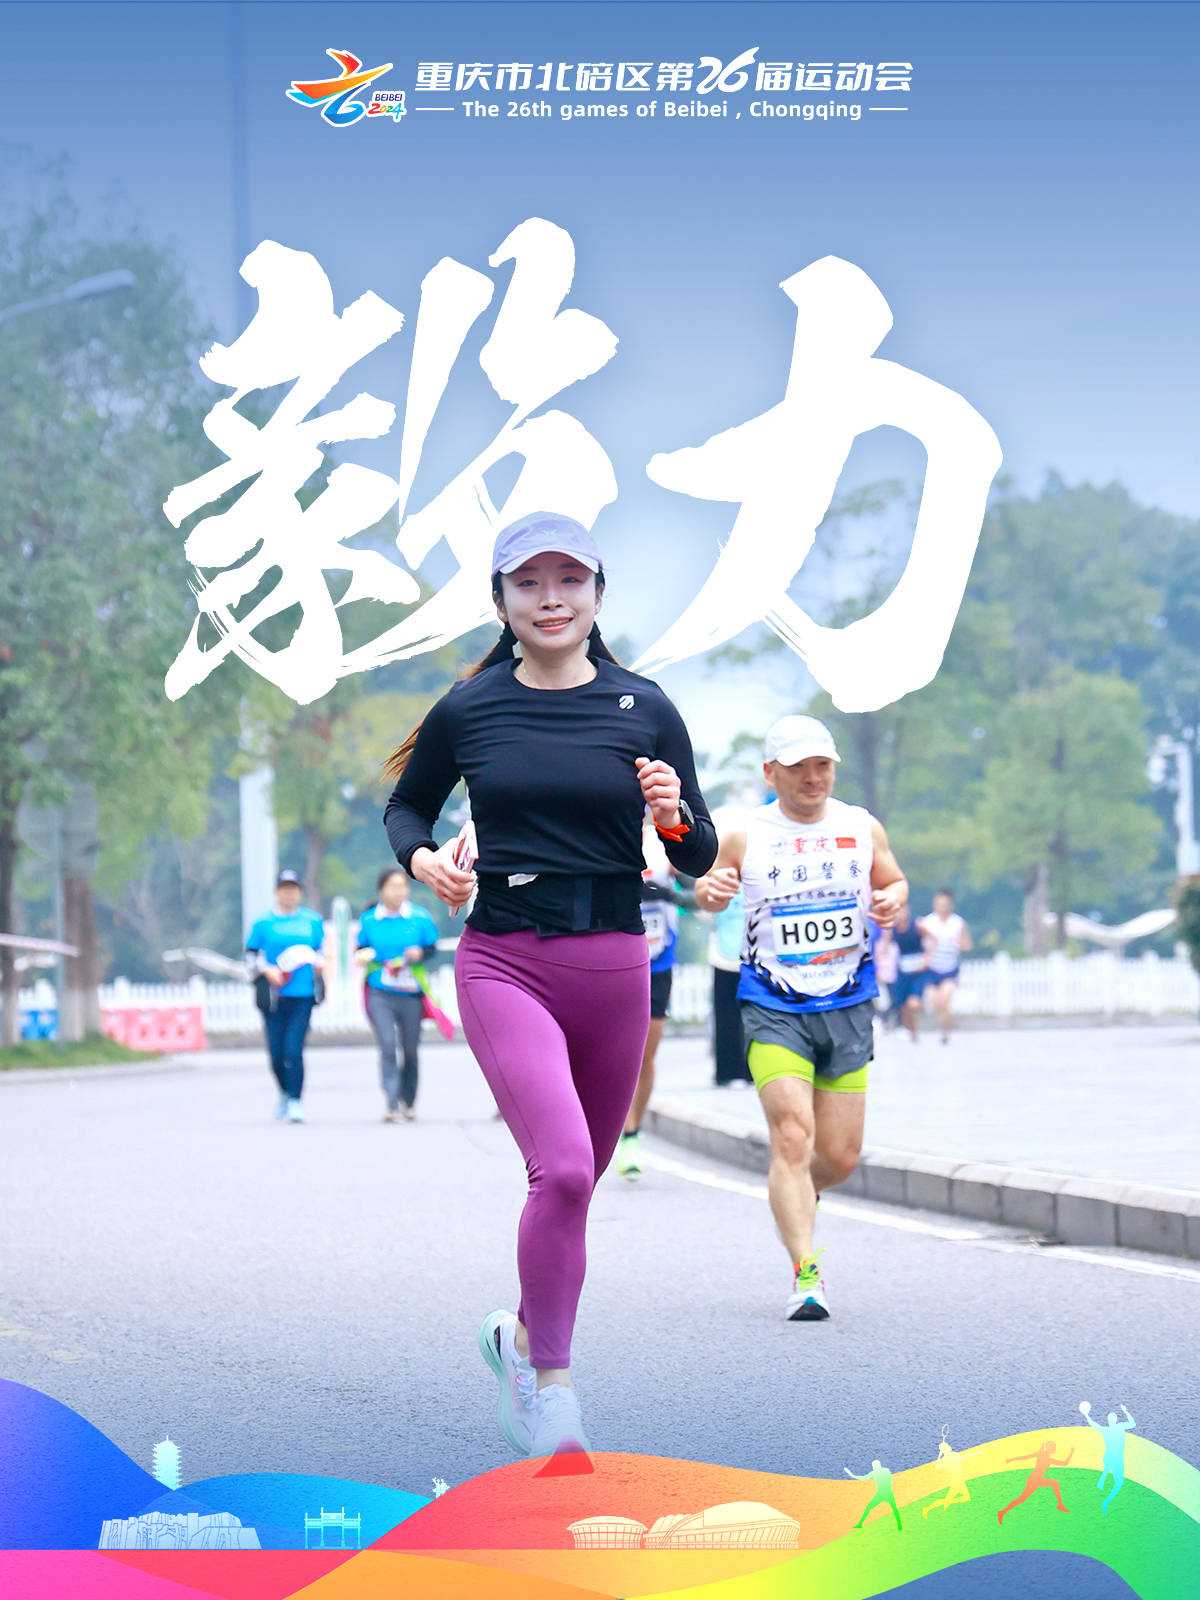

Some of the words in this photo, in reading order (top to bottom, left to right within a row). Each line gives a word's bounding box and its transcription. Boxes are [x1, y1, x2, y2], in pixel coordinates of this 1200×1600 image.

[791, 836, 833, 856] 重庆
[768, 860, 862, 888] 中国警察
[781, 916, 854, 945] H093
